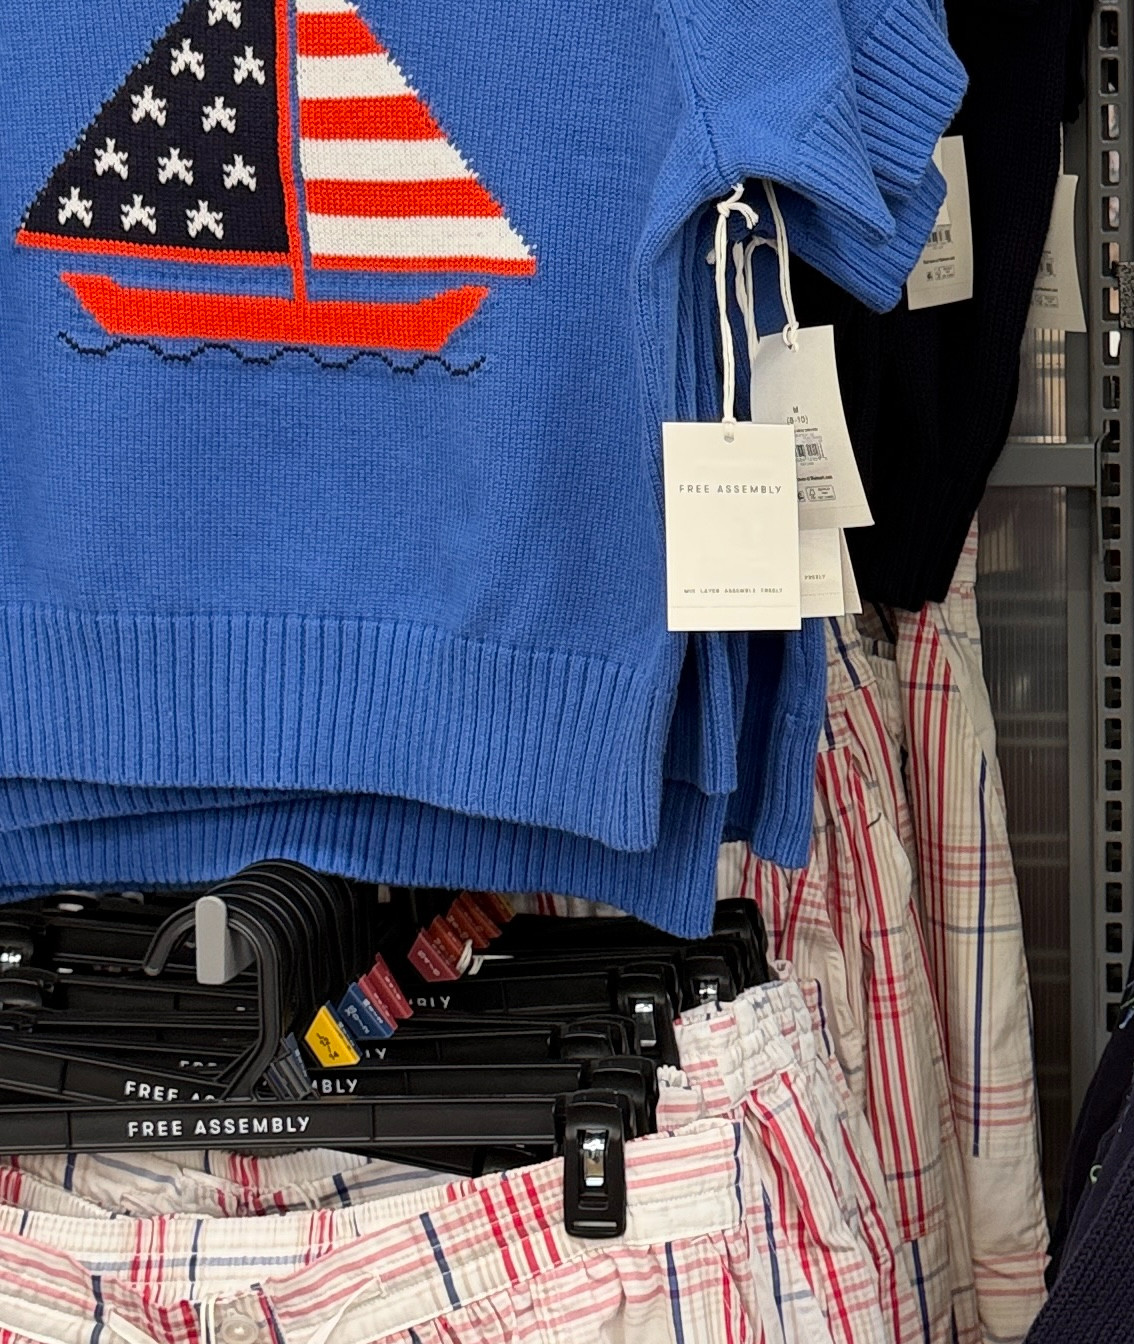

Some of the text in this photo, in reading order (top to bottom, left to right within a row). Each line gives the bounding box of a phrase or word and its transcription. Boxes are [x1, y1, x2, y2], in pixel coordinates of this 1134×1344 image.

[679, 484, 782, 494] FREE ASSEMBLY
[124, 1080, 178, 1102] FREE
[128, 1116, 310, 1138] FREE ASSEMBLY
